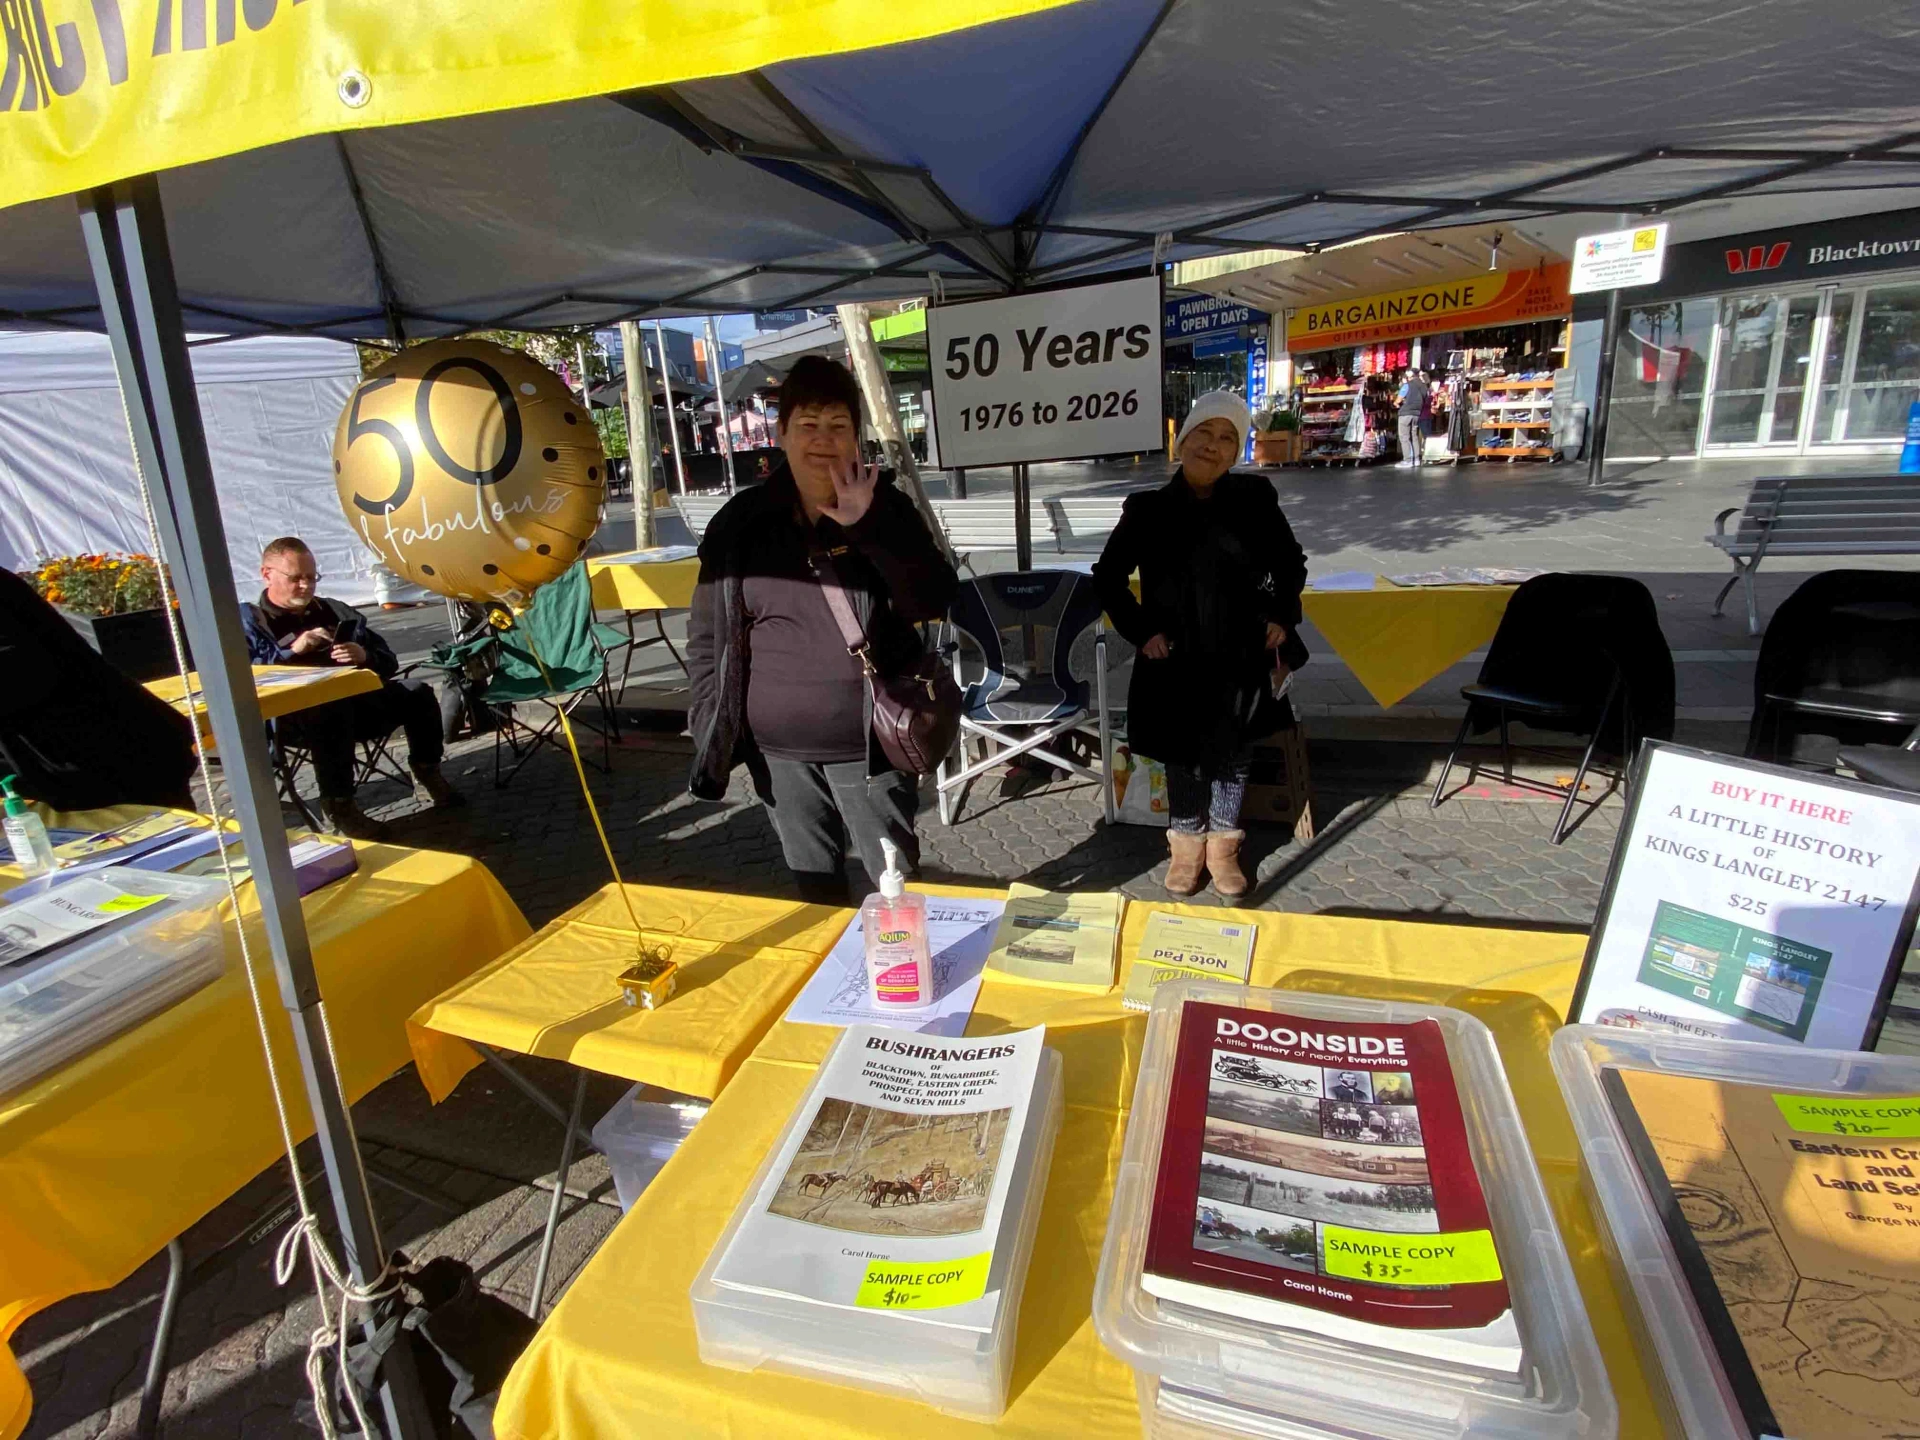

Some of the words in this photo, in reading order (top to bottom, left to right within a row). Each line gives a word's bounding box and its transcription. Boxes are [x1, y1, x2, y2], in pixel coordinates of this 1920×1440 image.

[1179, 297, 1235, 317] PAWNBRO
[1308, 286, 1475, 331] BARGAINZONE
[1181, 316, 1208, 332] OPEN
[1212, 314, 1218, 326] 7
[1221, 308, 1249, 325] DAYS
[1333, 328, 1367, 343] GIFTS
[1386, 318, 1441, 335] VARIETY
[945, 333, 1000, 380] 50
[1016, 324, 1151, 372] Years
[959, 401, 1024, 432] 1976
[1032, 401, 1058, 425] to
[1066, 388, 1139, 422] 2026
[347, 356, 522, 516] 50
[383, 477, 572, 564] fabulous
[1710, 780, 1756, 802] BUY
[1760, 792, 1784, 808] IT
[1788, 799, 1853, 826] HERE
[1668, 804, 1683, 819] A
[1688, 808, 1768, 840] LITTLE
[1771, 828, 1883, 869] HISTORY
[1752, 846, 1776, 860] OF
[1644, 834, 1710, 864] KINGS
[1712, 853, 1819, 894] LANGLEY
[1822, 884, 1887, 912] 2147
[1727, 893, 1768, 916] $25
[879, 932, 910, 942] AQIUM
[1154, 949, 1184, 962] Pad
[1190, 954, 1228, 968] Note
[1780, 945, 1820, 962] LANGLEY
[1638, 1006, 1667, 1022] CASH
[1669, 1019, 1692, 1032] and
[1216, 1018, 1406, 1056] DOONSIDE
[865, 1036, 1016, 1062] BUSHRANGERS
[1226, 1038, 1248, 1048] little
[1252, 1042, 1290, 1056] History
[1309, 1053, 1344, 1064] nearly
[1348, 1056, 1409, 1067] Everything
[861, 1069, 914, 1086] DOONSIDE,
[917, 1080, 962, 1088] EASTERN
[962, 1078, 998, 1087] CREEK,
[865, 1060, 926, 1079] BLACKTOWN,
[930, 1069, 1000, 1080] BUNGARRIBEE,
[869, 1080, 923, 1097] PROSPECT,
[962, 1088, 984, 1096] HILL
[880, 1092, 902, 1103] AND
[903, 1096, 936, 1106] SEVEN
[937, 1098, 966, 1106] HILLS
[1798, 1105, 1873, 1118] SAMPLE
[1876, 1106, 1920, 1118] COPY
[1788, 1139, 1888, 1160] Eastern
[1890, 1147, 1920, 1160] Cr
[1865, 1165, 1916, 1178] and
[1813, 1173, 1880, 1194] Land
[1892, 1202, 1913, 1213] By
[1845, 1211, 1902, 1227] George
[841, 1248, 864, 1258] Carol
[865, 1251, 891, 1260] Horne
[1330, 1239, 1402, 1260] SAMPLE
[1408, 1246, 1456, 1260] COPY
[866, 1272, 923, 1286] SAMPLE
[927, 1269, 964, 1285] COPY
[1283, 1279, 1315, 1293] Carol
[1318, 1286, 1353, 1302] Horne
